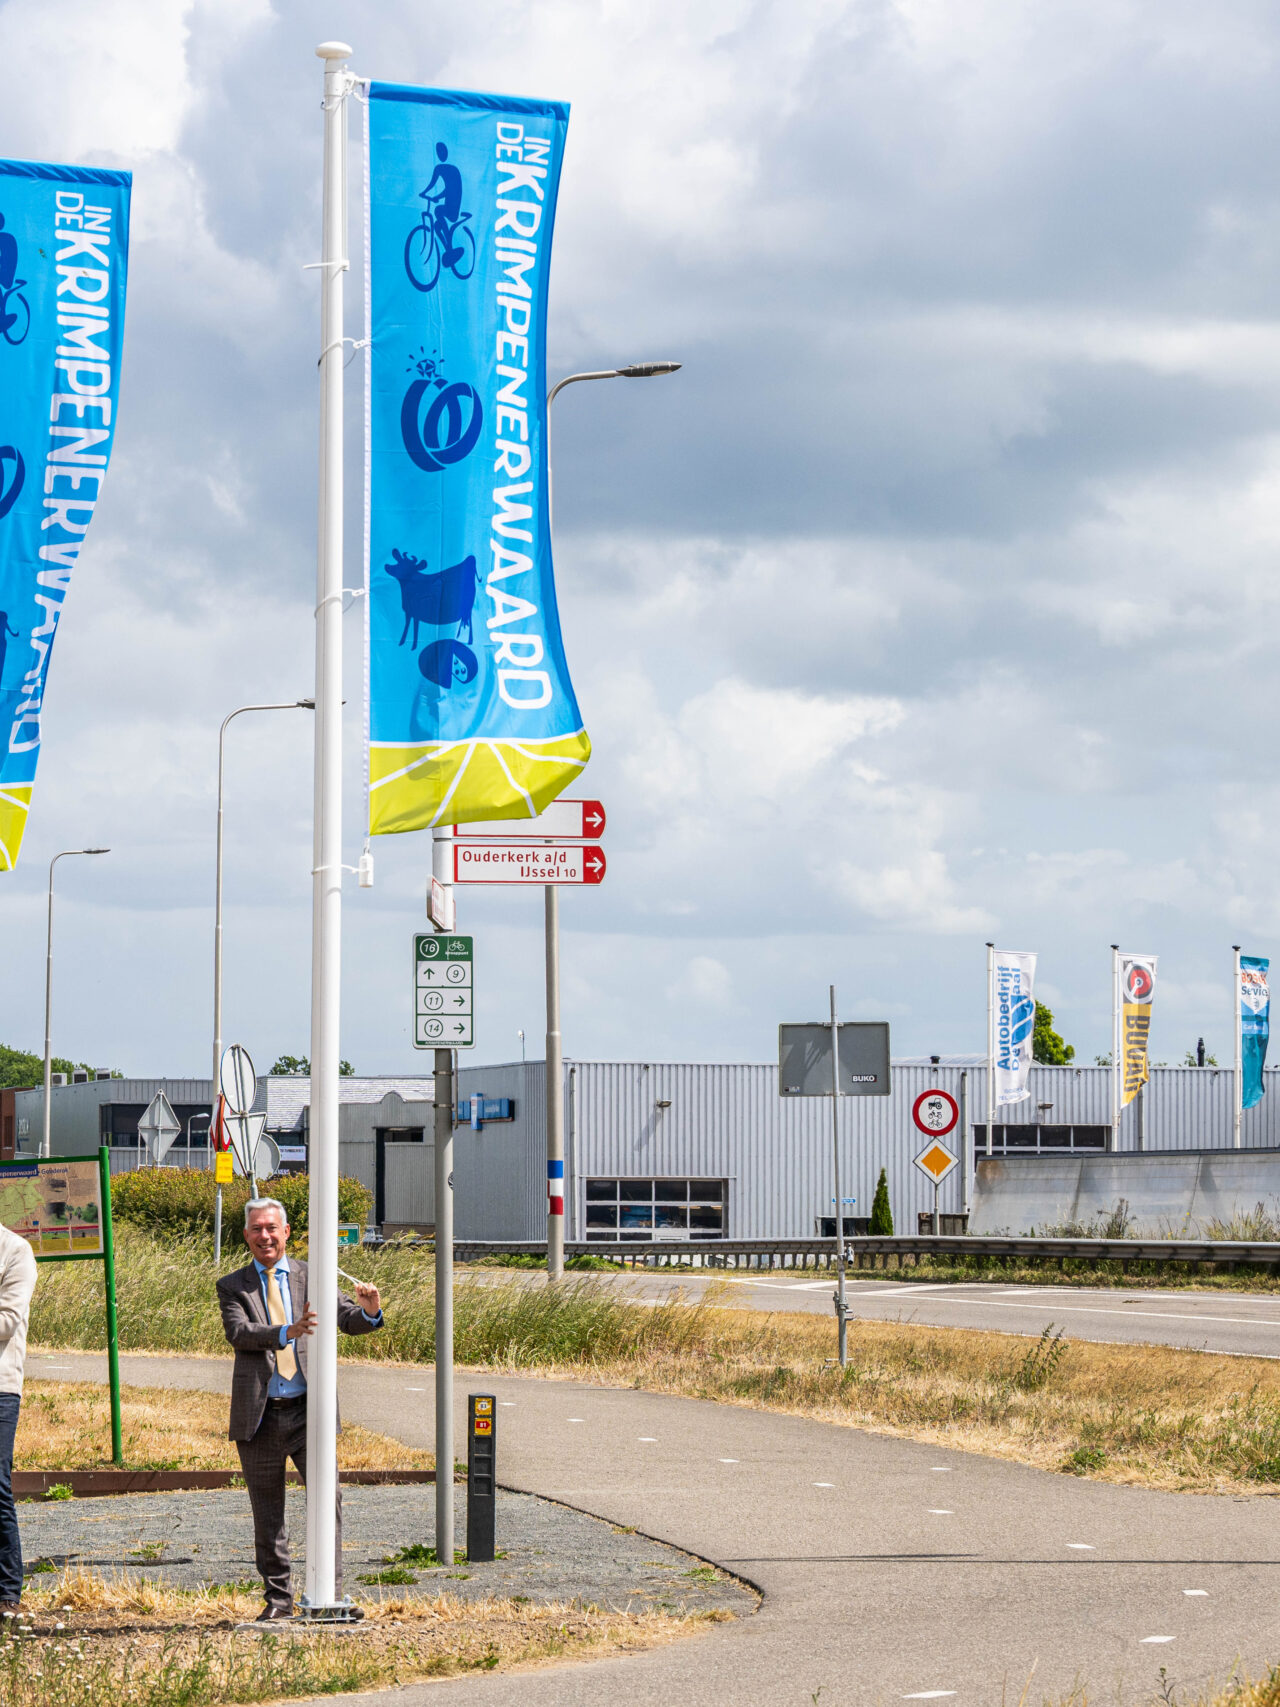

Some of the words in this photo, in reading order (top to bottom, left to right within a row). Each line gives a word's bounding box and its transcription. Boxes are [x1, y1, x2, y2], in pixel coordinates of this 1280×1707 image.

[496, 121, 524, 162] DE
[523, 136, 552, 165] IN
[55, 190, 84, 229] DE
[83, 204, 112, 232] IN
[485, 161, 553, 710] KRIMPENERWAARD
[462, 850, 540, 863] Ouderkerk
[544, 851, 567, 866] a/d
[520, 865, 560, 878] IJssel
[563, 868, 577, 878] 10
[424, 944, 436, 953] 16
[452, 969, 459, 979] 9
[428, 997, 439, 1006] 11
[428, 1024, 440, 1033] 14
[997, 966, 1011, 1071] Autobedrijf
[1011, 1047, 1021, 1071] De
